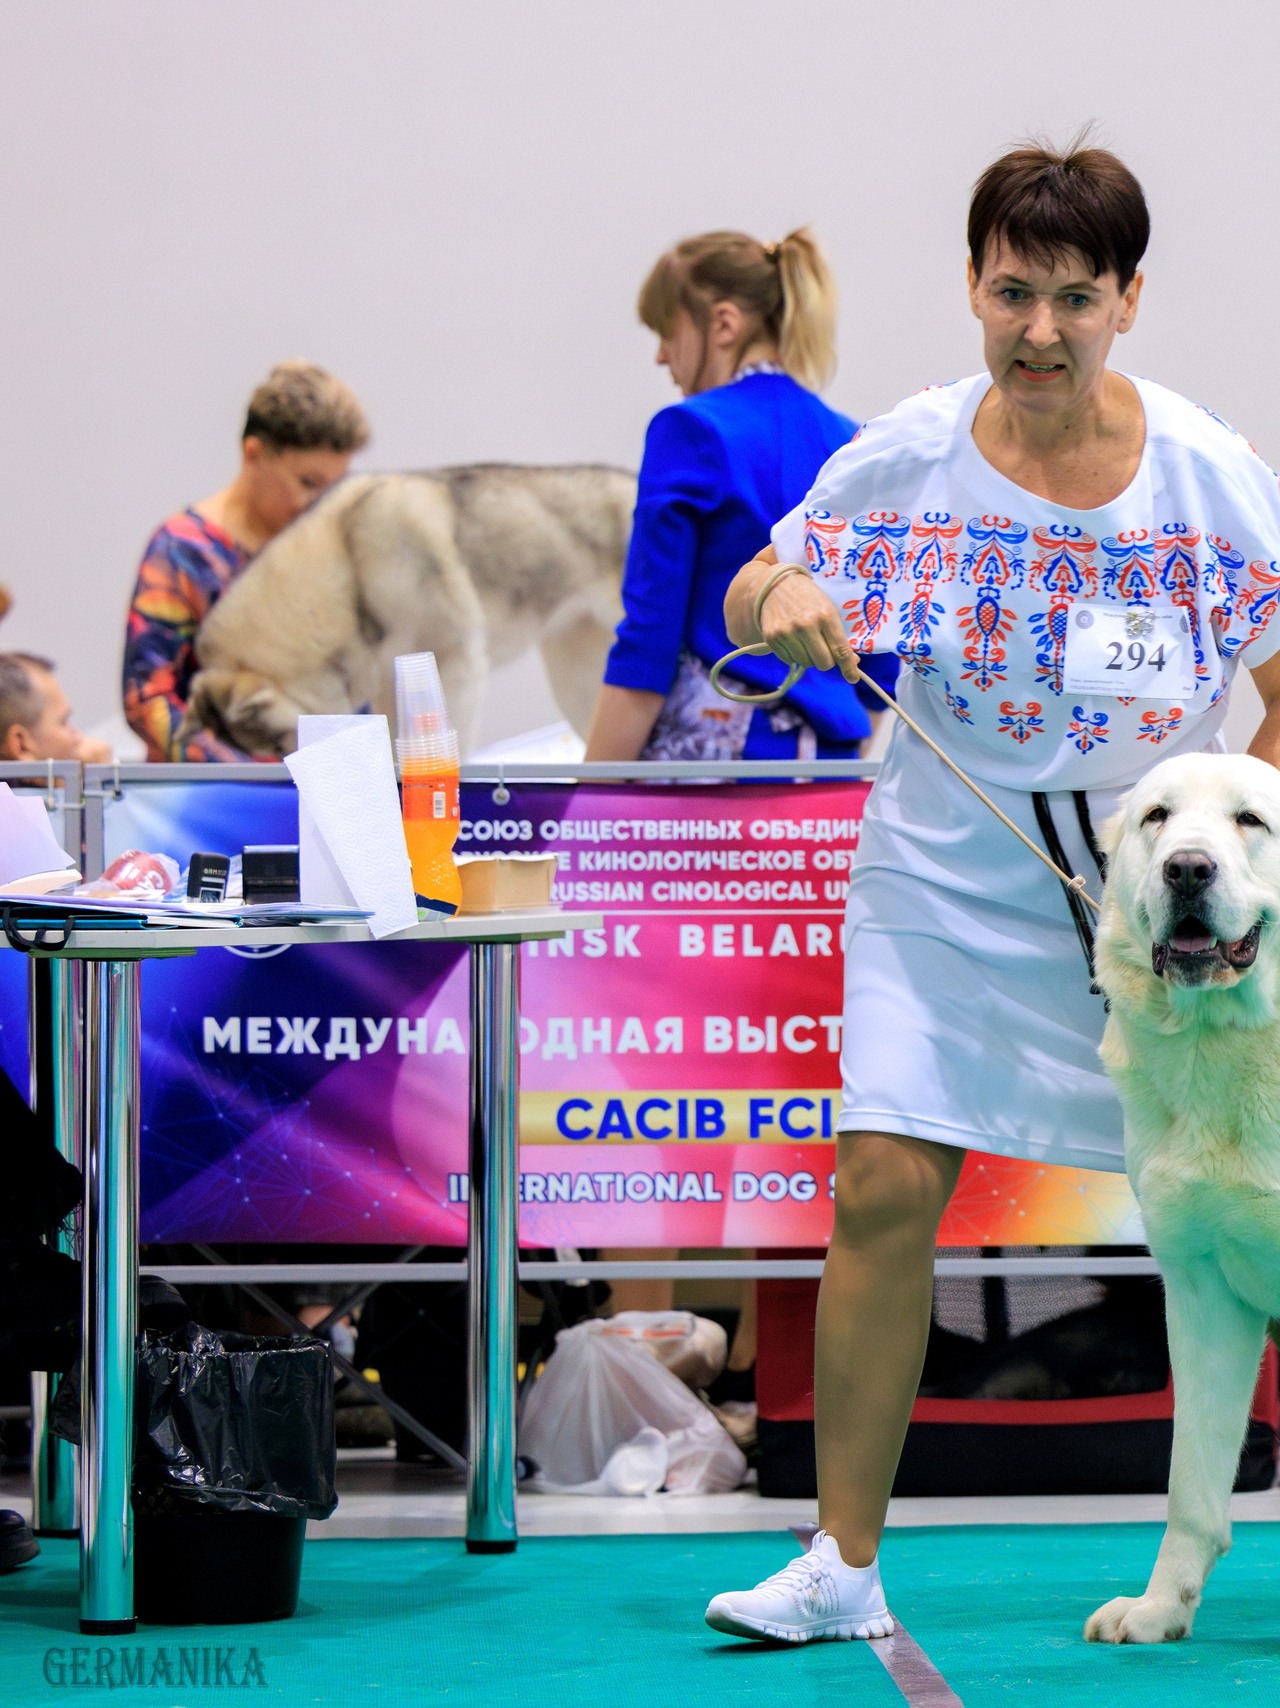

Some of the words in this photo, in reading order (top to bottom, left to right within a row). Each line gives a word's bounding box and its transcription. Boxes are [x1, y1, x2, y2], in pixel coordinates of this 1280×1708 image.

[1105, 641, 1166, 672] 294
[458, 819, 534, 841] СОЮЗ
[540, 819, 743, 844] ОБЩЕСТВЕННЫХ
[749, 818, 863, 843] ОБЪЕДИН
[578, 849, 806, 872] КИНОЛОГИЧЕСКОЕ
[550, 880, 645, 903] RUSSIAN
[651, 879, 818, 902] CINOLOGICAL
[678, 923, 845, 957] BELAR
[704, 1014, 843, 1054] ВЫСТ
[556, 1097, 726, 1140] CACIB
[749, 1097, 832, 1139] FCI
[732, 1171, 818, 1202] DOG
